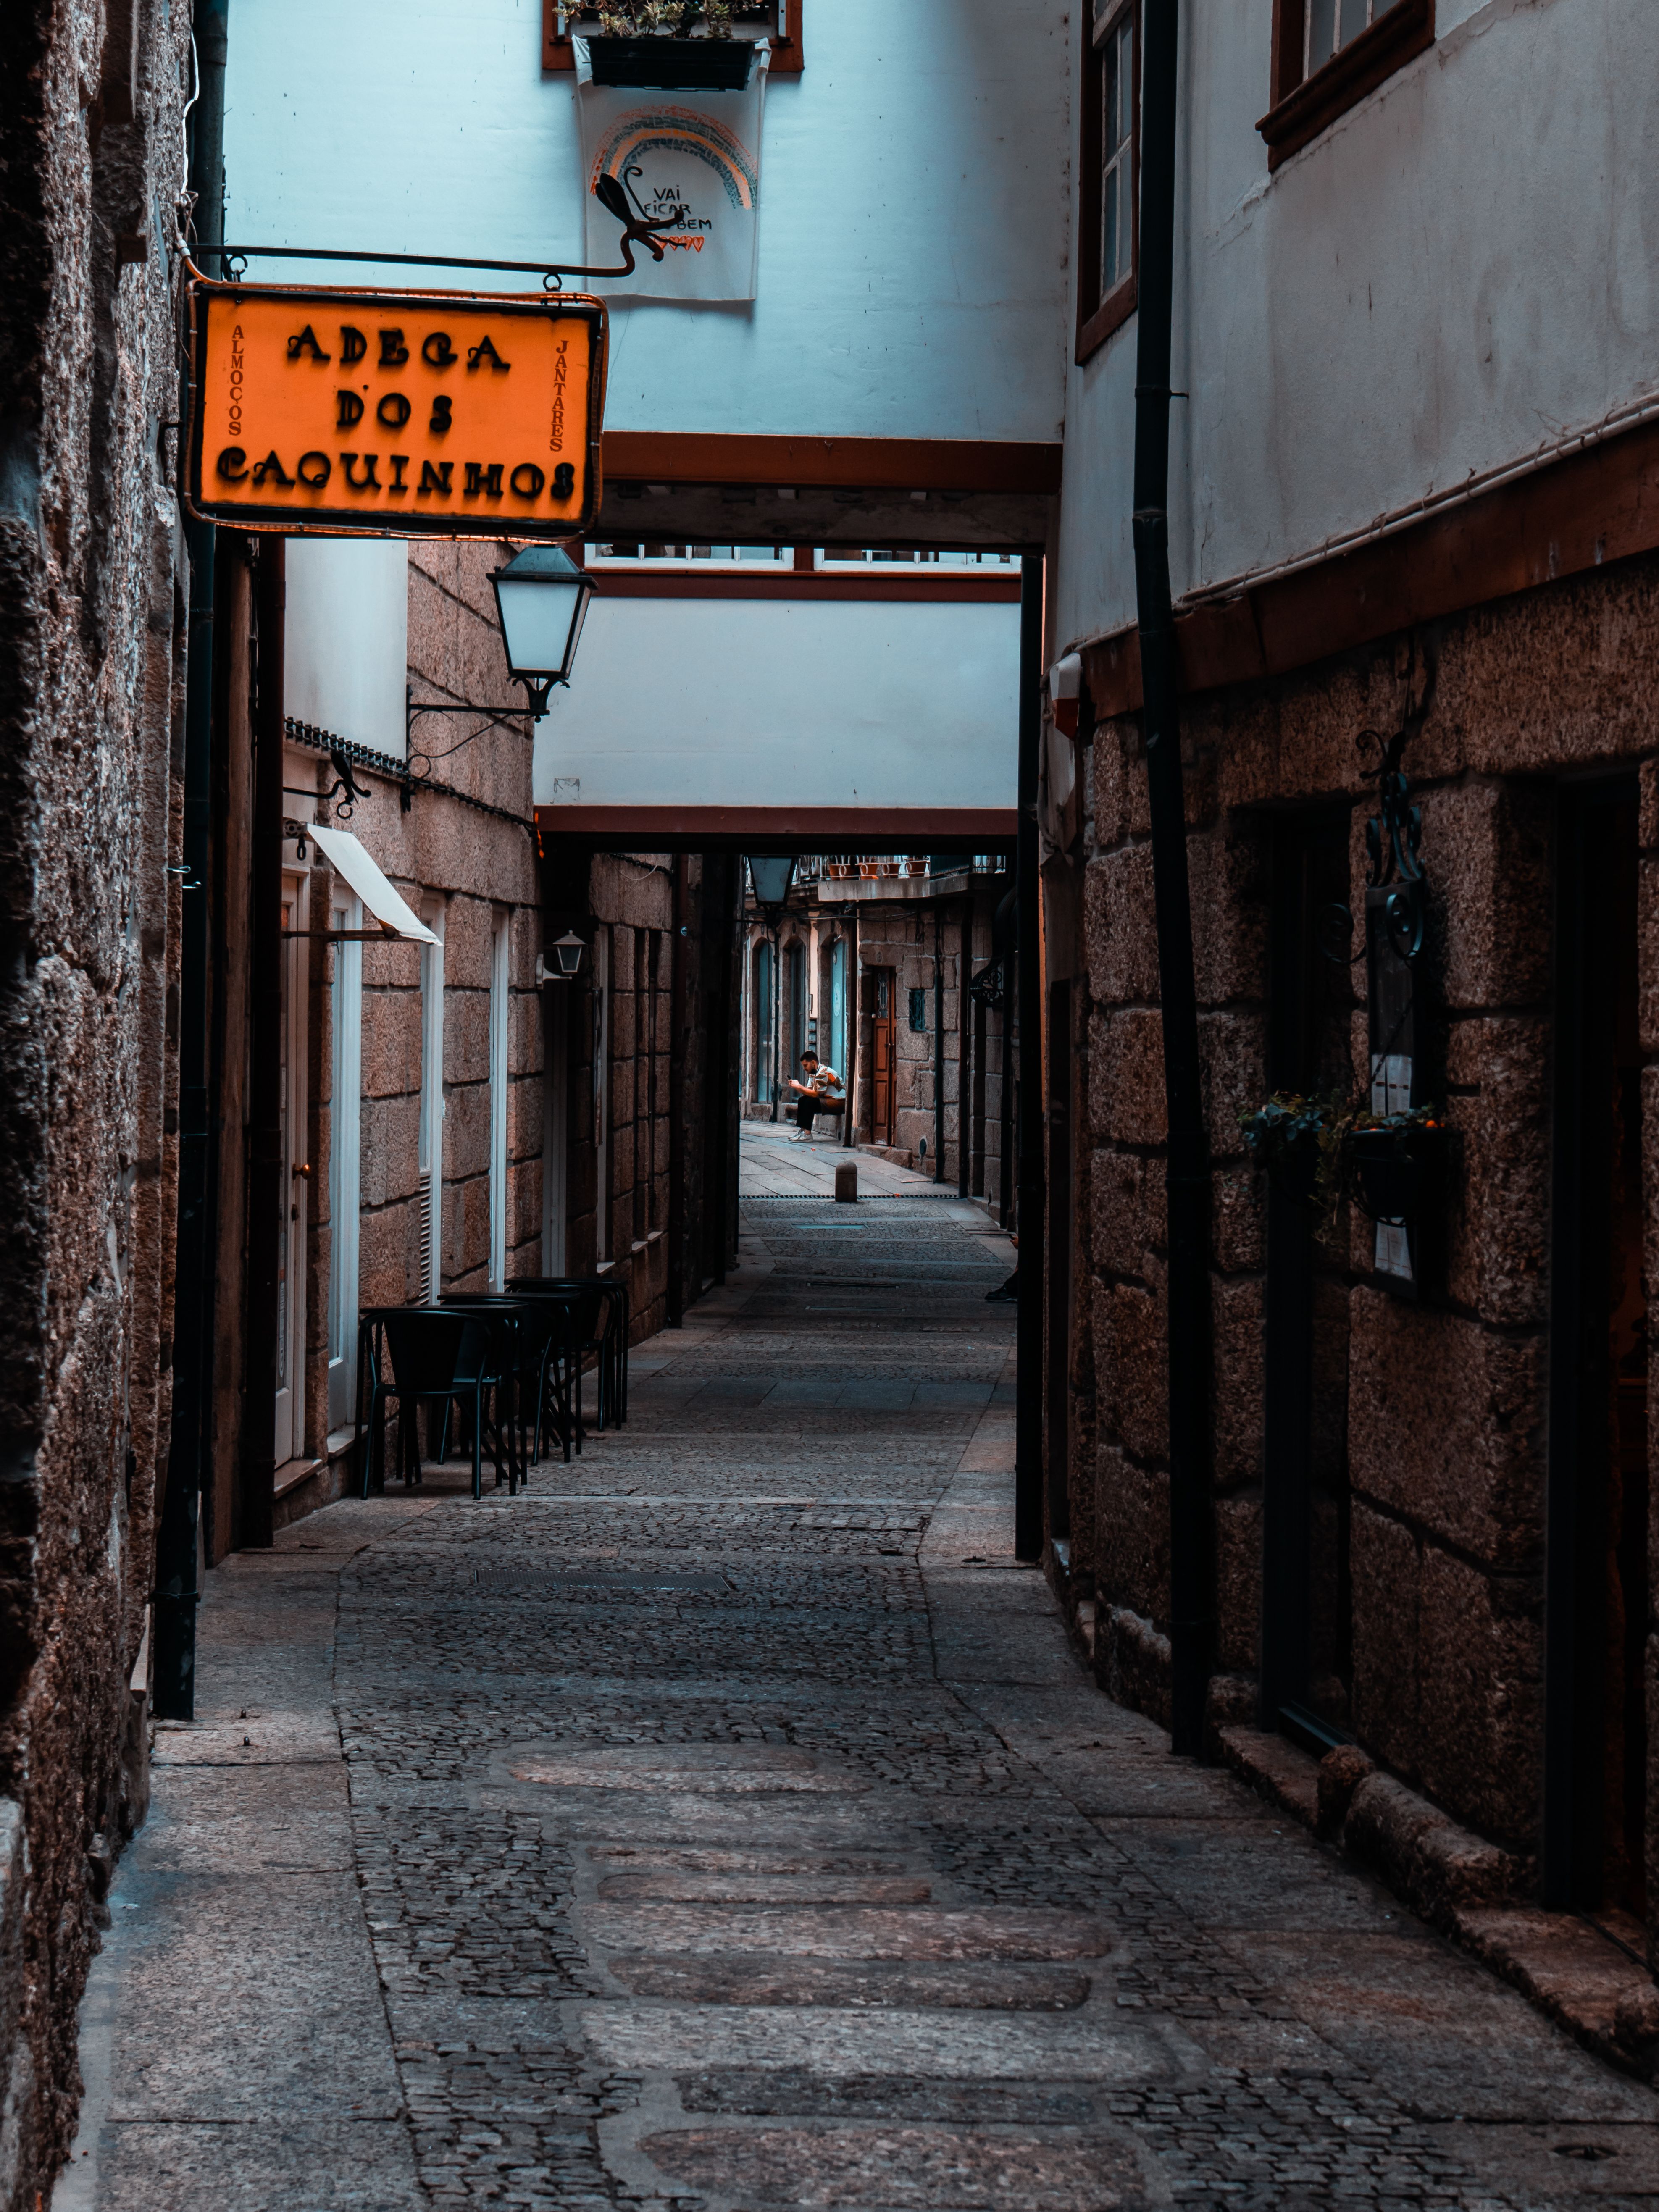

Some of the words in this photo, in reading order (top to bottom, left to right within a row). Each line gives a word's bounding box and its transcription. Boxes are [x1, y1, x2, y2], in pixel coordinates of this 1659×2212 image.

[677, 218, 712, 230] BEM
[287, 325, 511, 372] ADEGA
[228, 325, 245, 436] ALMOÇOS
[549, 340, 569, 452] JANTARES
[217, 447, 575, 499] CAQUINHOS
